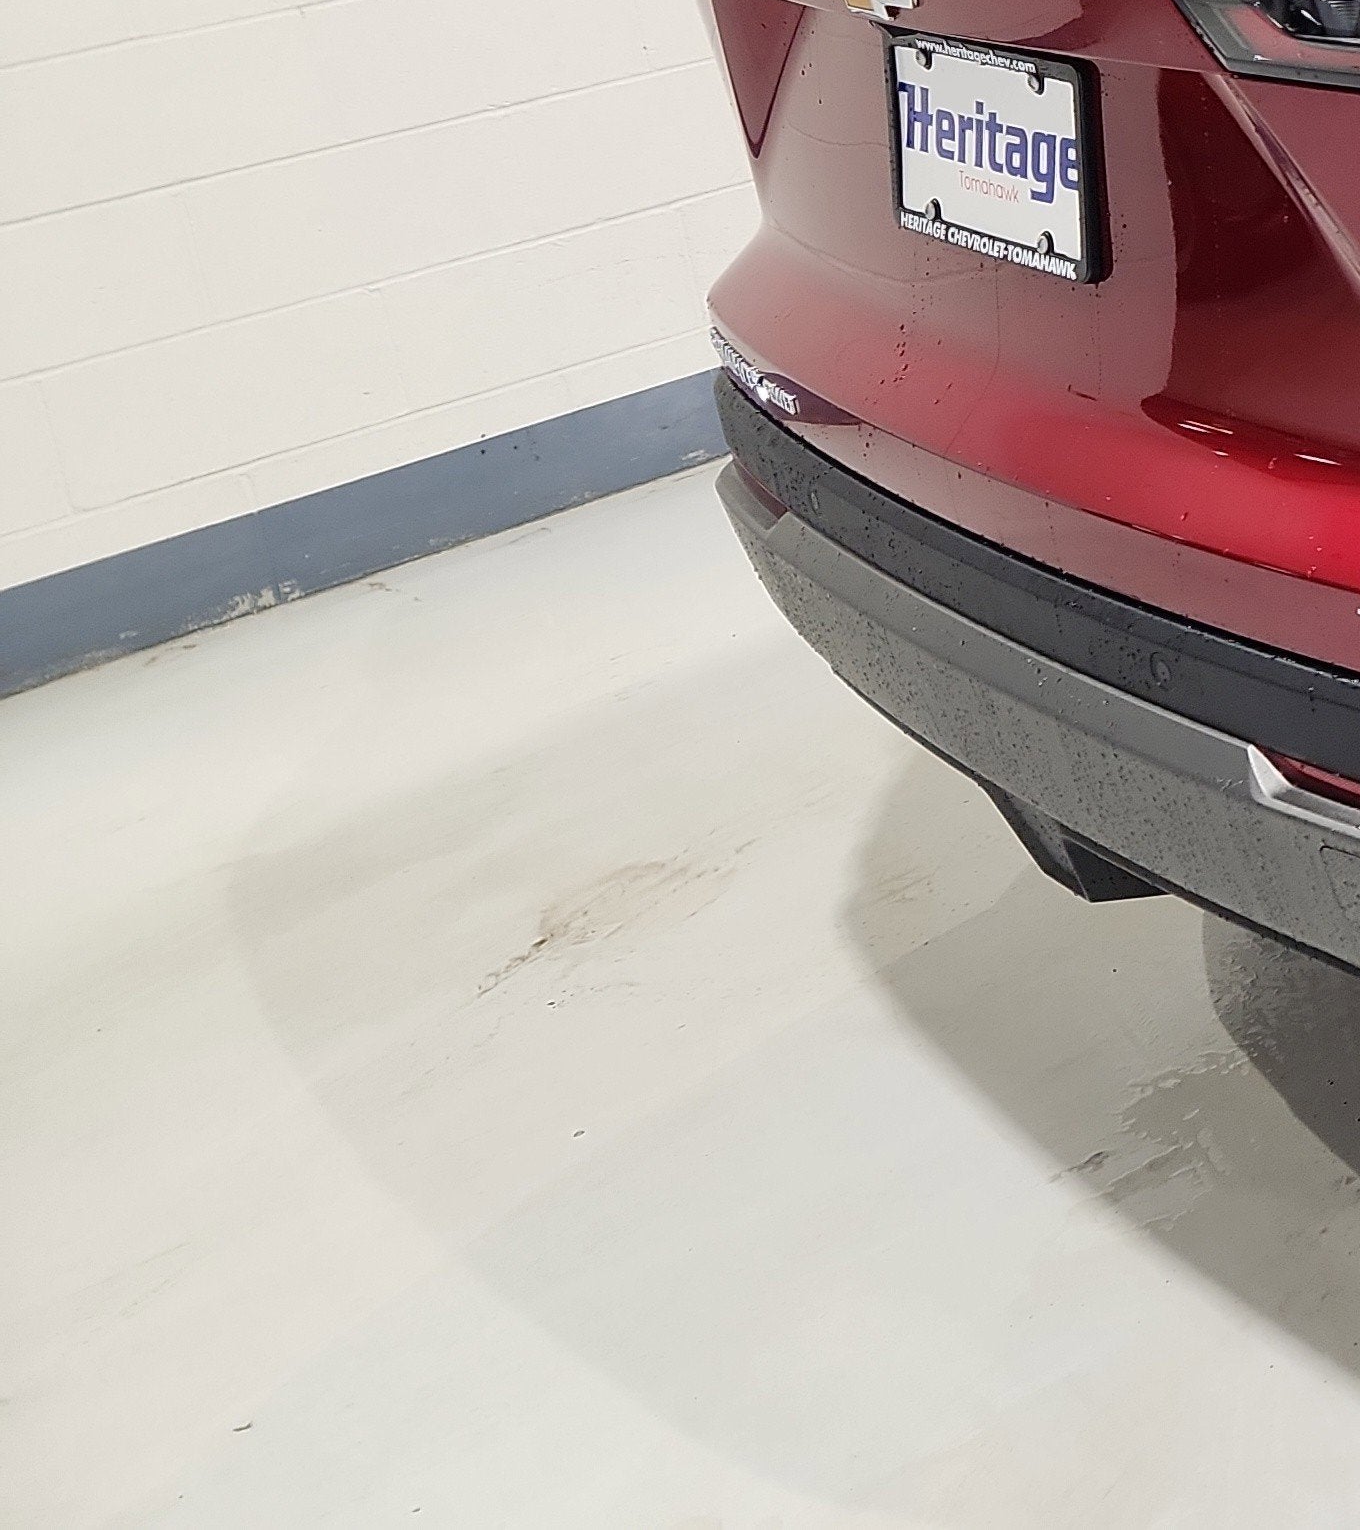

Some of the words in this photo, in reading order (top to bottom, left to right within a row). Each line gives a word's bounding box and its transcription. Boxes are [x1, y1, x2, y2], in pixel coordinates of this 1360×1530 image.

[915, 38, 1037, 74] www.heritagechev.com
[898, 81, 1080, 204] Heritage
[958, 170, 1020, 204] Tomahawk
[900, 212, 948, 241] HERITAGE
